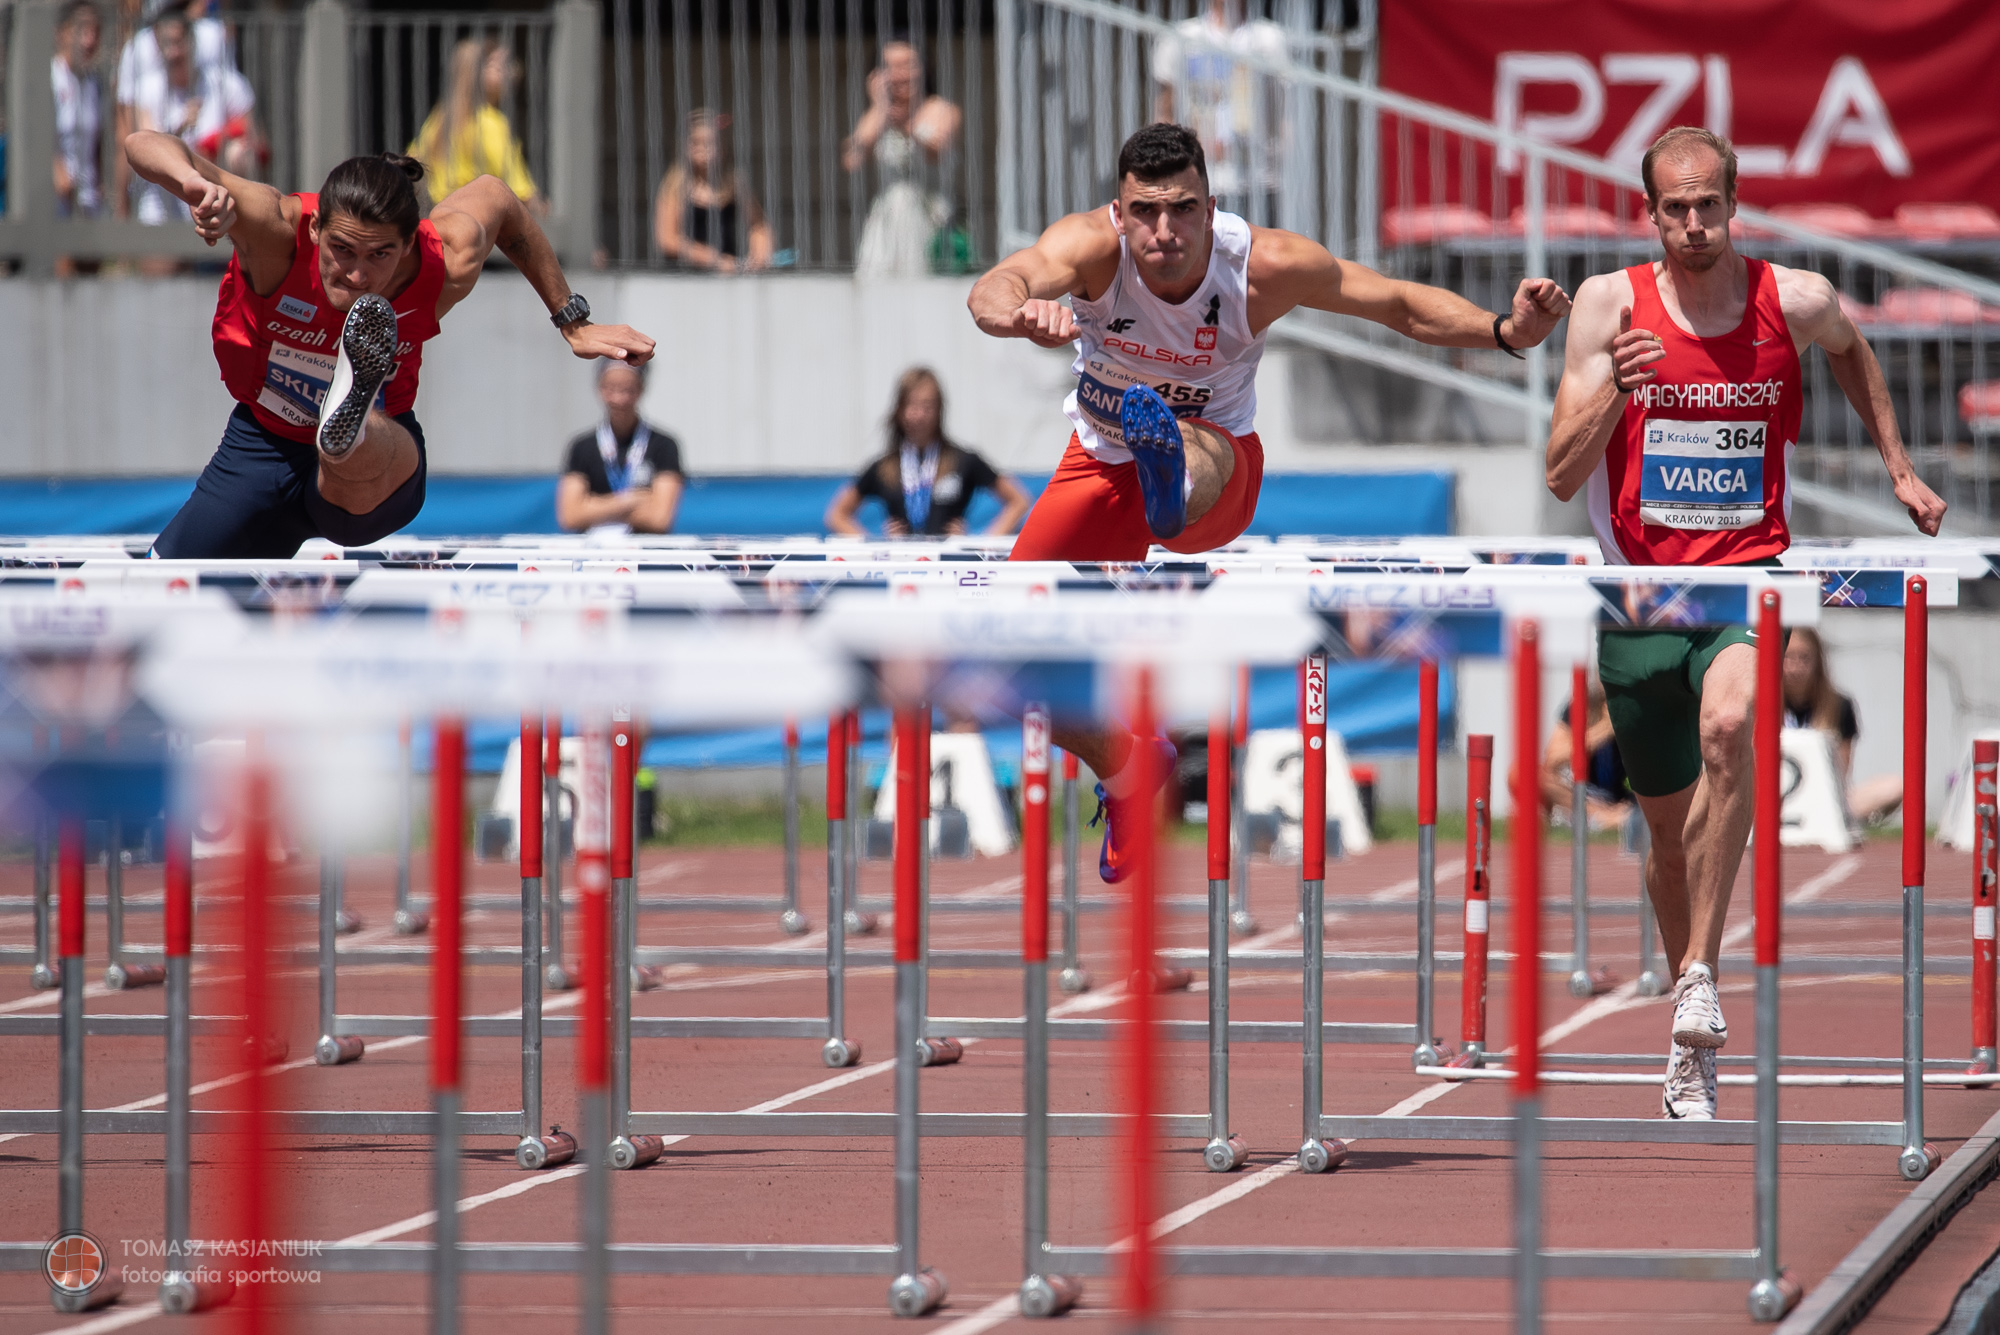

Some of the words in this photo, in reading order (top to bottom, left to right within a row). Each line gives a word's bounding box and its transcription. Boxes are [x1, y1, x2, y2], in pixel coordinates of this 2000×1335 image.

[1494, 52, 1911, 177] PZLA
[266, 320, 328, 347] czech
[1107, 318, 1136, 334] 4F
[294, 352, 336, 372] Kraków
[1103, 338, 1212, 367] POLSKA
[1105, 368, 1148, 387] Kraków
[1153, 382, 1211, 403] 455
[1633, 378, 1783, 408] MAGYARORSZÁG
[281, 405, 320, 427] KRAKÓ
[1667, 432, 1709, 444] Kraków
[1715, 427, 1765, 450] 364
[1659, 465, 1748, 493] VARGA
[1665, 512, 1715, 525] KRAKÓW
[1717, 515, 1741, 525] 2018
[1421, 584, 1496, 608] U23
